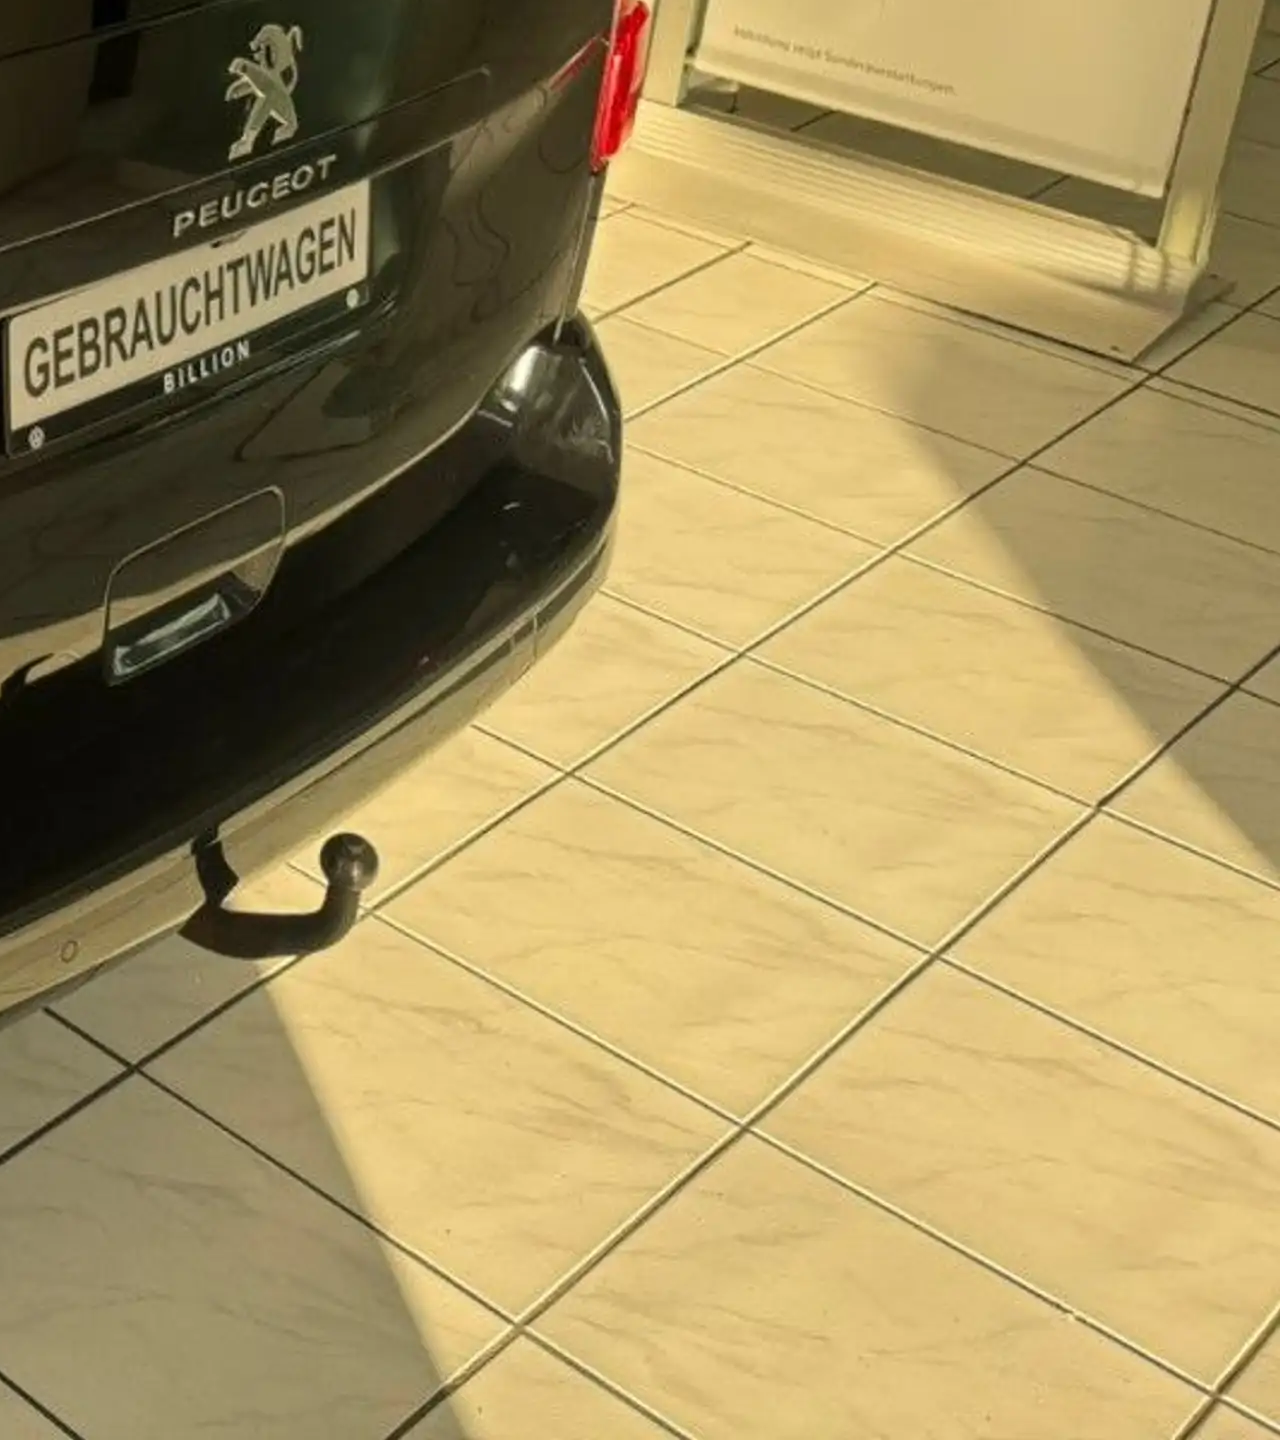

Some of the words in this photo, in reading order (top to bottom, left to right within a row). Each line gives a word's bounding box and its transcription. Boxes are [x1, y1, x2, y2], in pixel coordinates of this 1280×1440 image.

[172, 155, 337, 239] PEUGEOT
[23, 208, 357, 398] GEBRAUCHTWAGEN
[163, 338, 251, 395] BILLION
